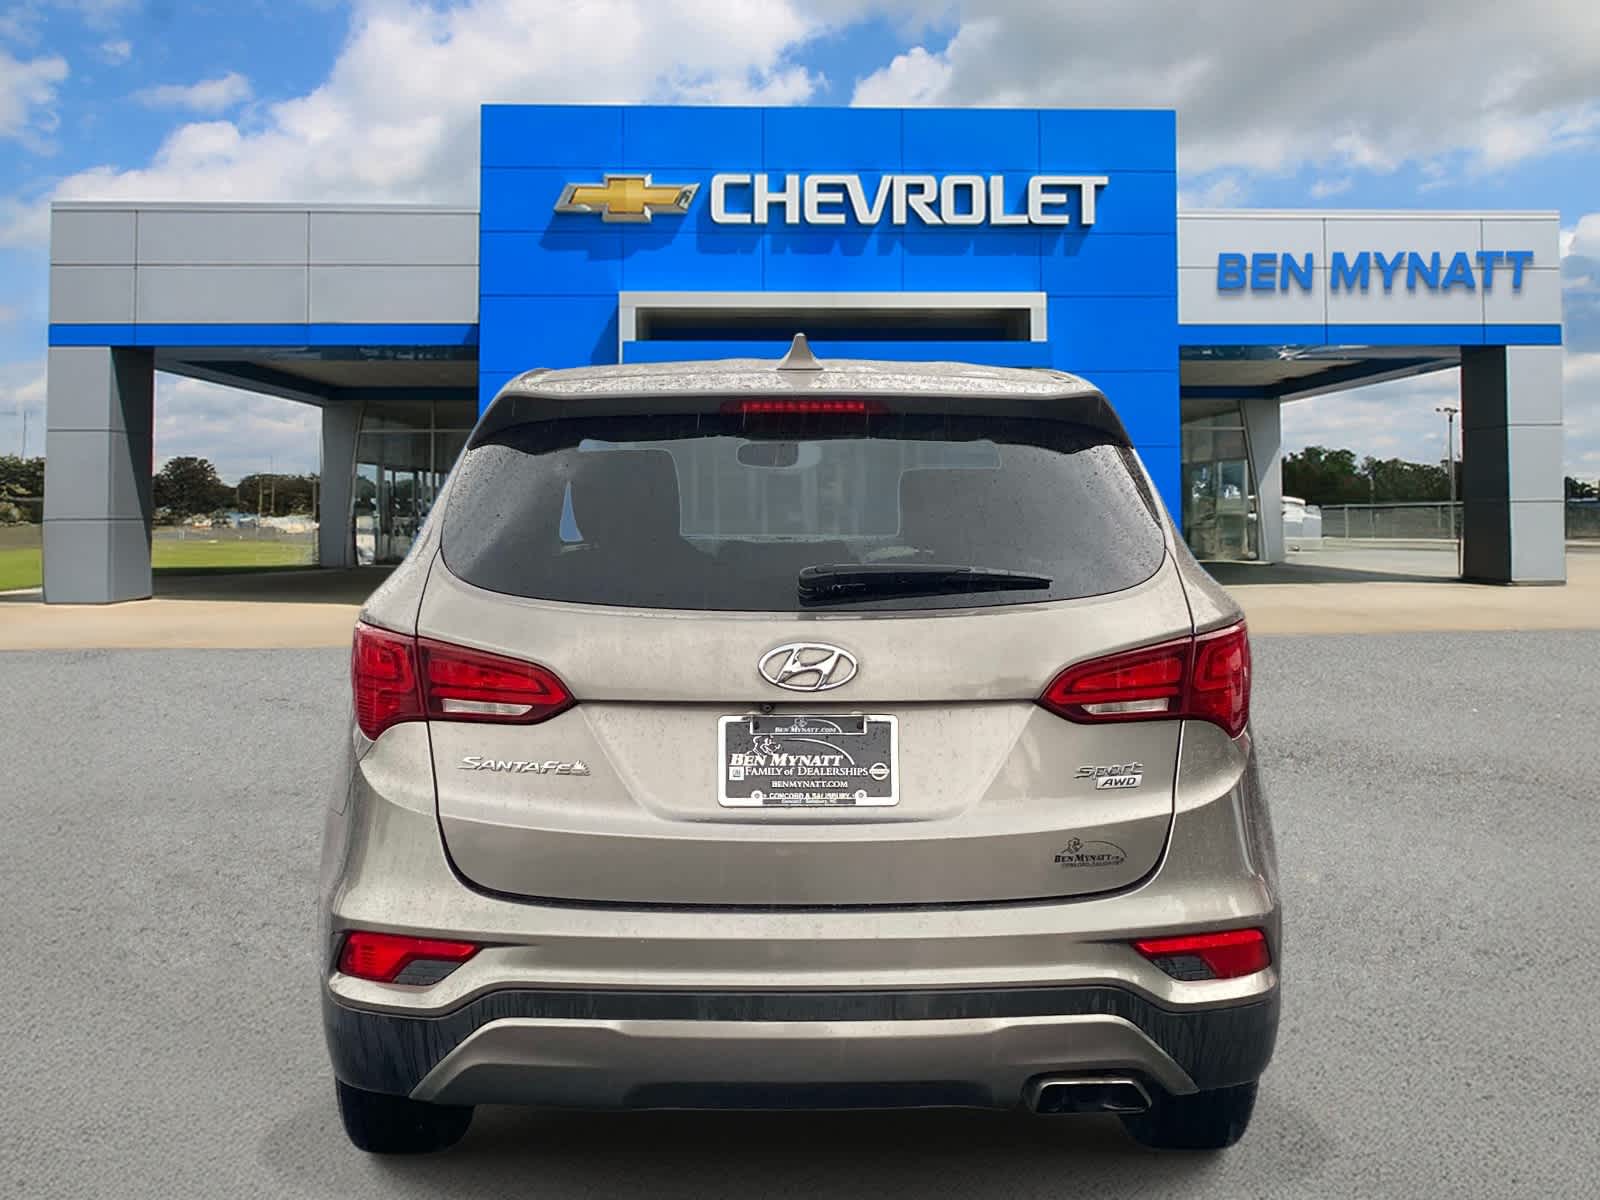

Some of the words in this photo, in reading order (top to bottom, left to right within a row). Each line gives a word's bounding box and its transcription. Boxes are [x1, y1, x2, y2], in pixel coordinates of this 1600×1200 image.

[711, 173, 1110, 226] CHEVROLET
[1217, 252, 1313, 291] BEN
[1330, 250, 1534, 291] MYNATT
[730, 753, 766, 766] BEN
[770, 753, 844, 766] MYNATT
[745, 766, 781, 776] FAMILY
[783, 767, 794, 776] of
[797, 766, 869, 776] DEALERSHIPS
[771, 780, 848, 788] BENMYNATT.COM
[1102, 777, 1136, 787] AWD
